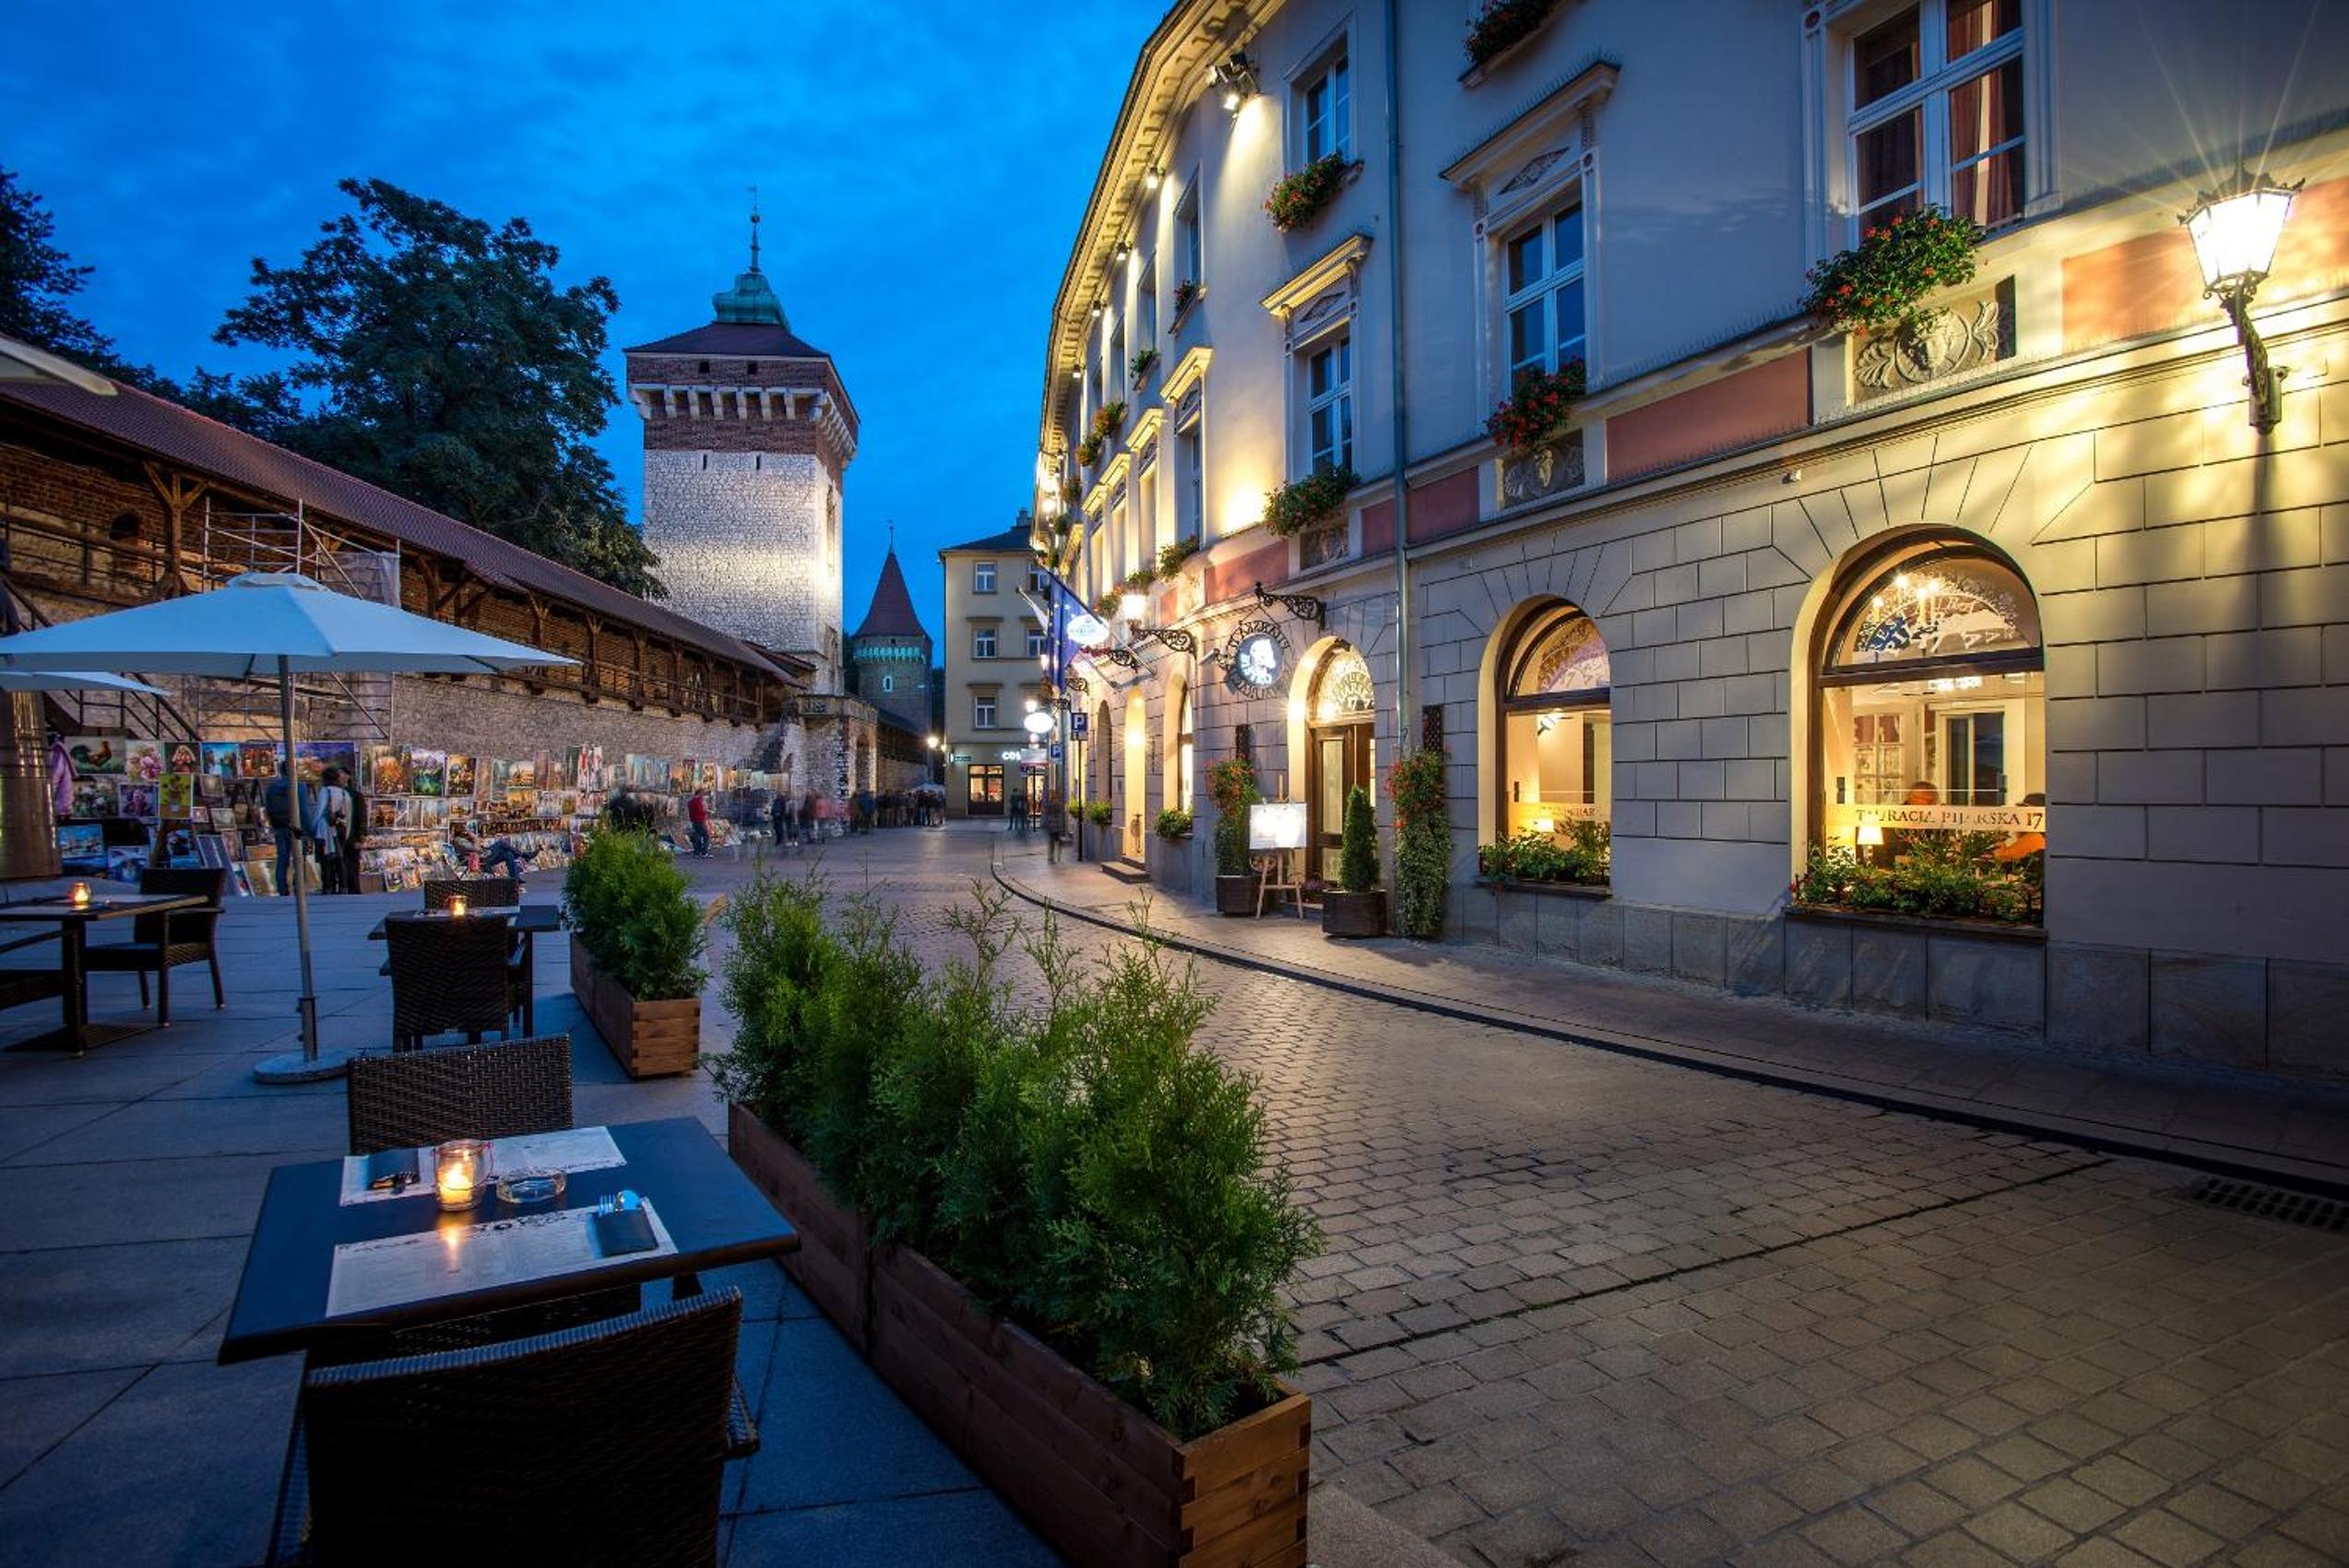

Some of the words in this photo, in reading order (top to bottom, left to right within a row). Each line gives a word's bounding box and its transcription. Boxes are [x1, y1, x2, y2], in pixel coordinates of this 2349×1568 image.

[1074, 714, 1085, 729] P
[1941, 812, 2020, 826] PIJRSKA
[2026, 812, 2043, 830] 17
